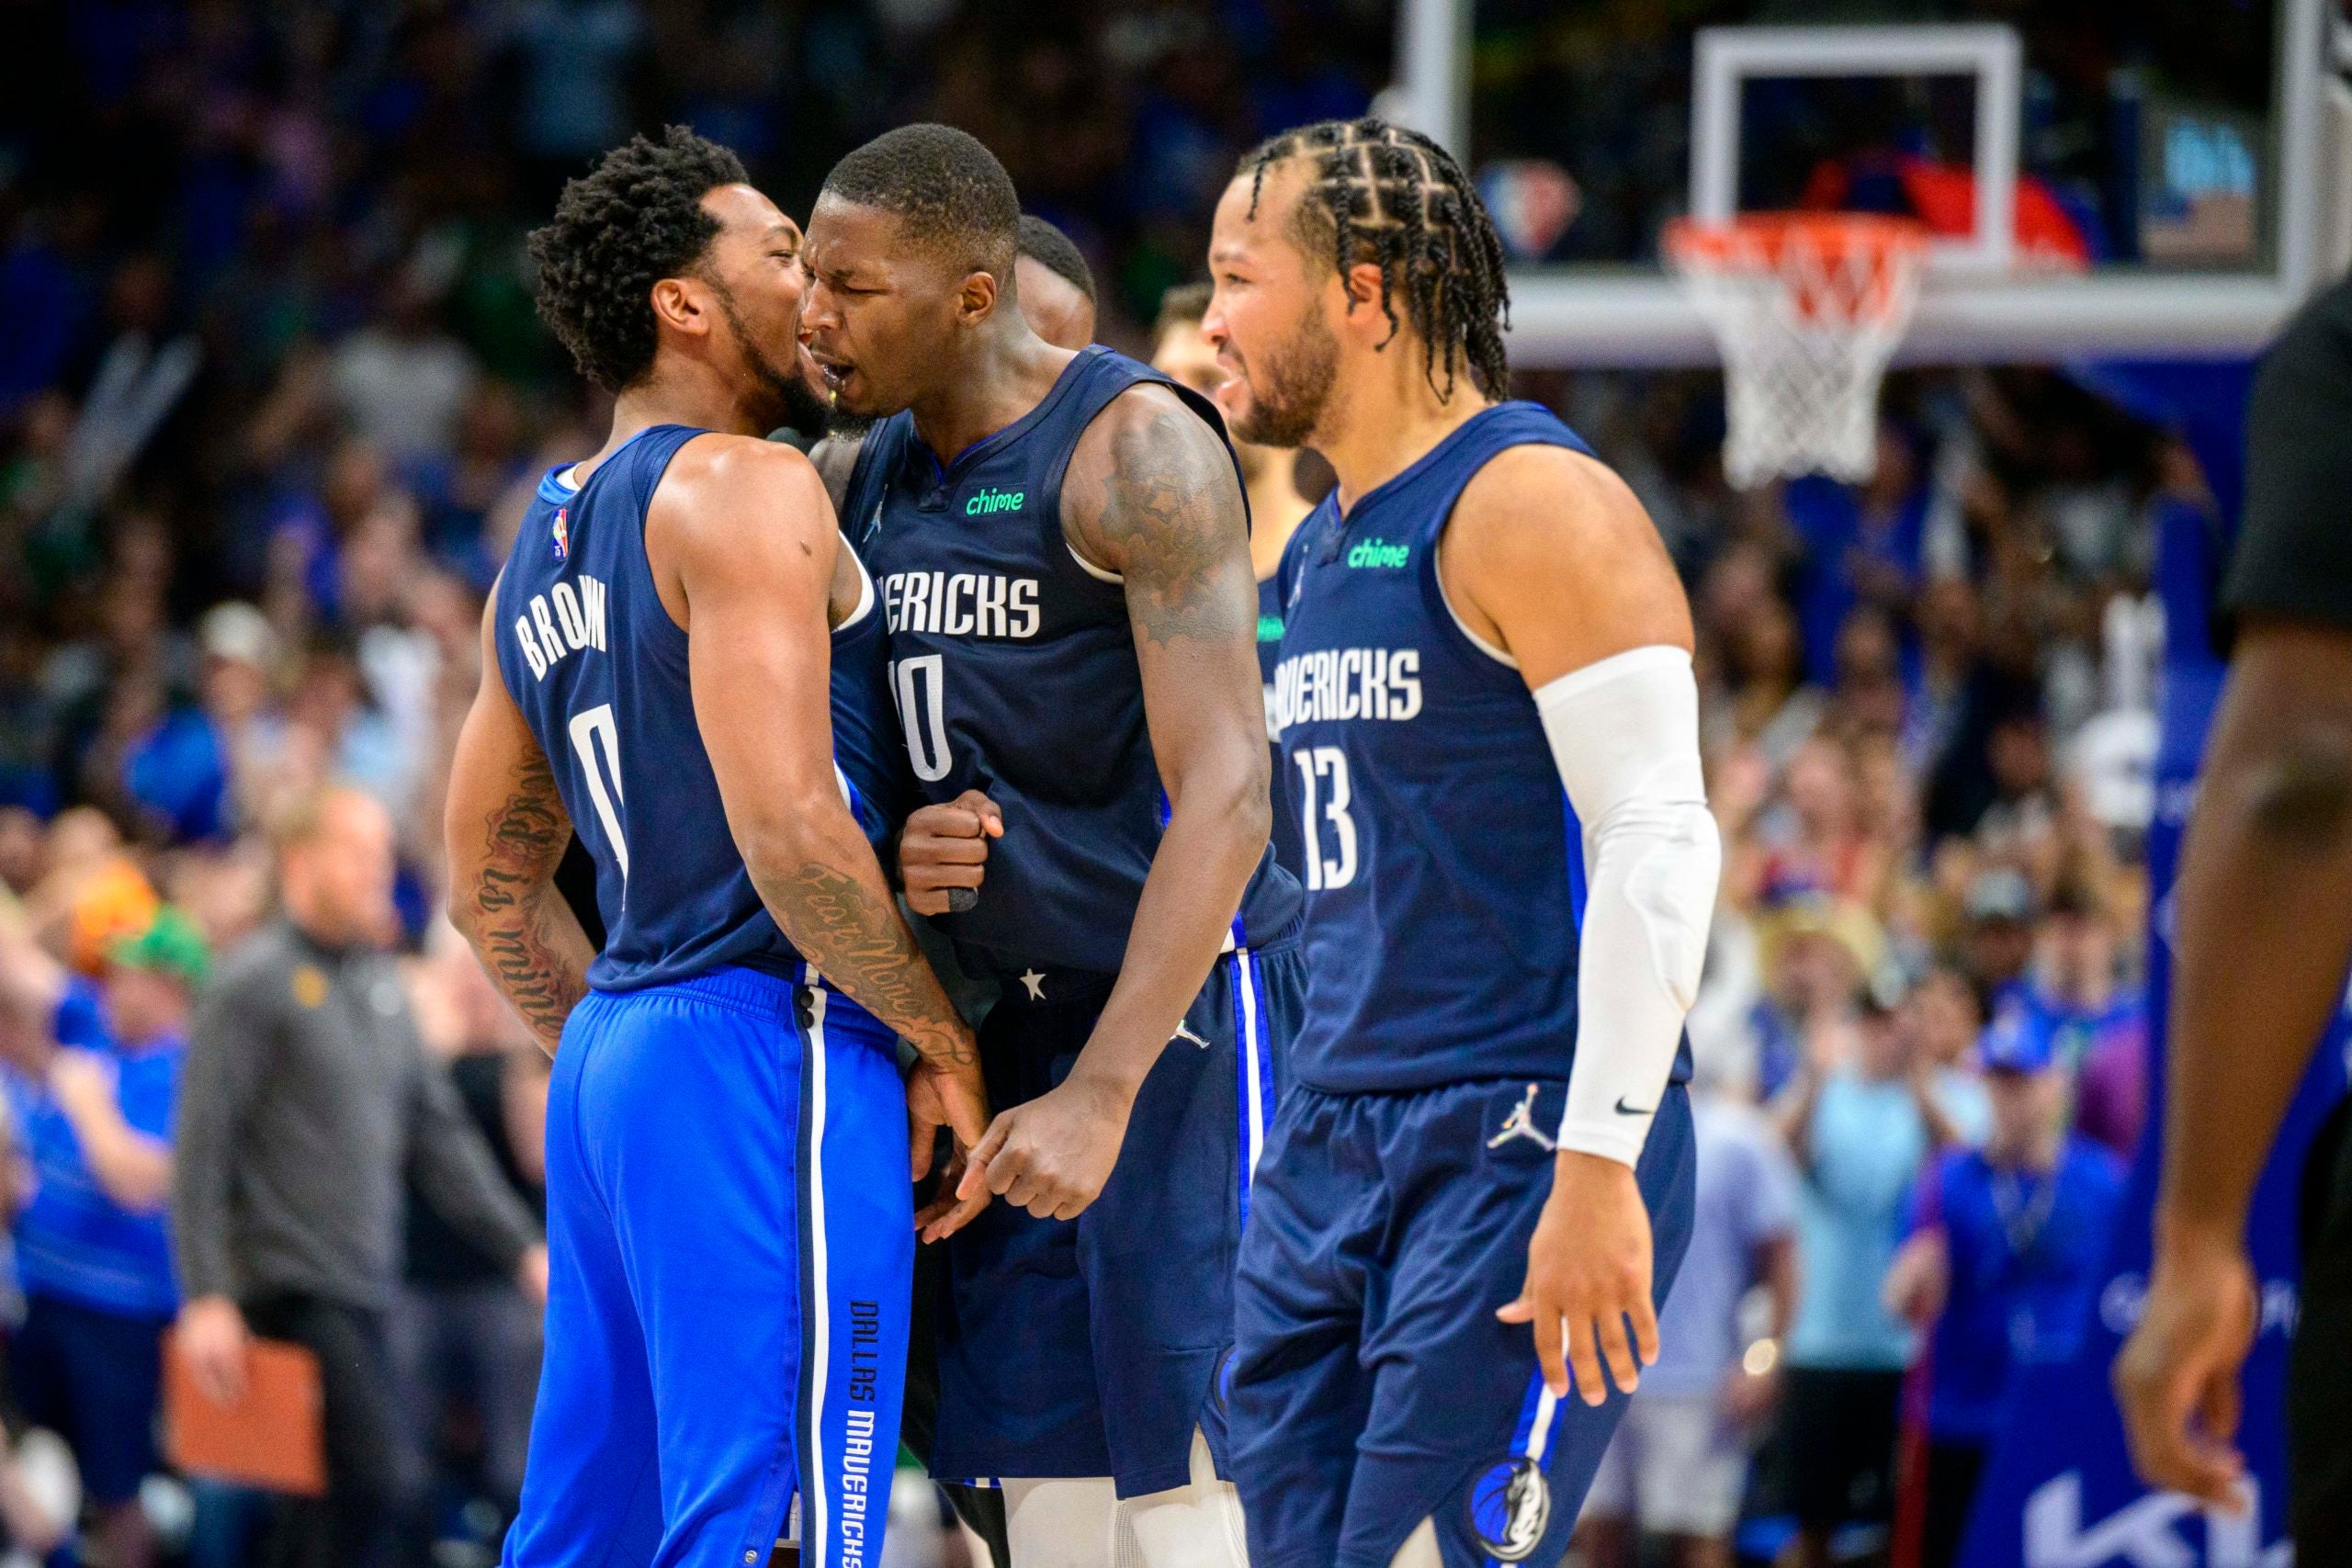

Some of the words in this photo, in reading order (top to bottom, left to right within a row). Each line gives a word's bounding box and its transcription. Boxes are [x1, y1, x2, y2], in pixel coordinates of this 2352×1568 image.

[966, 487, 1024, 515] chime
[1348, 537, 1410, 569] chime
[515, 574, 606, 682] BROWN
[877, 570, 1040, 638] ERICKS
[1294, 746, 1358, 890] 13
[849, 1300, 878, 1402] DALLAS
